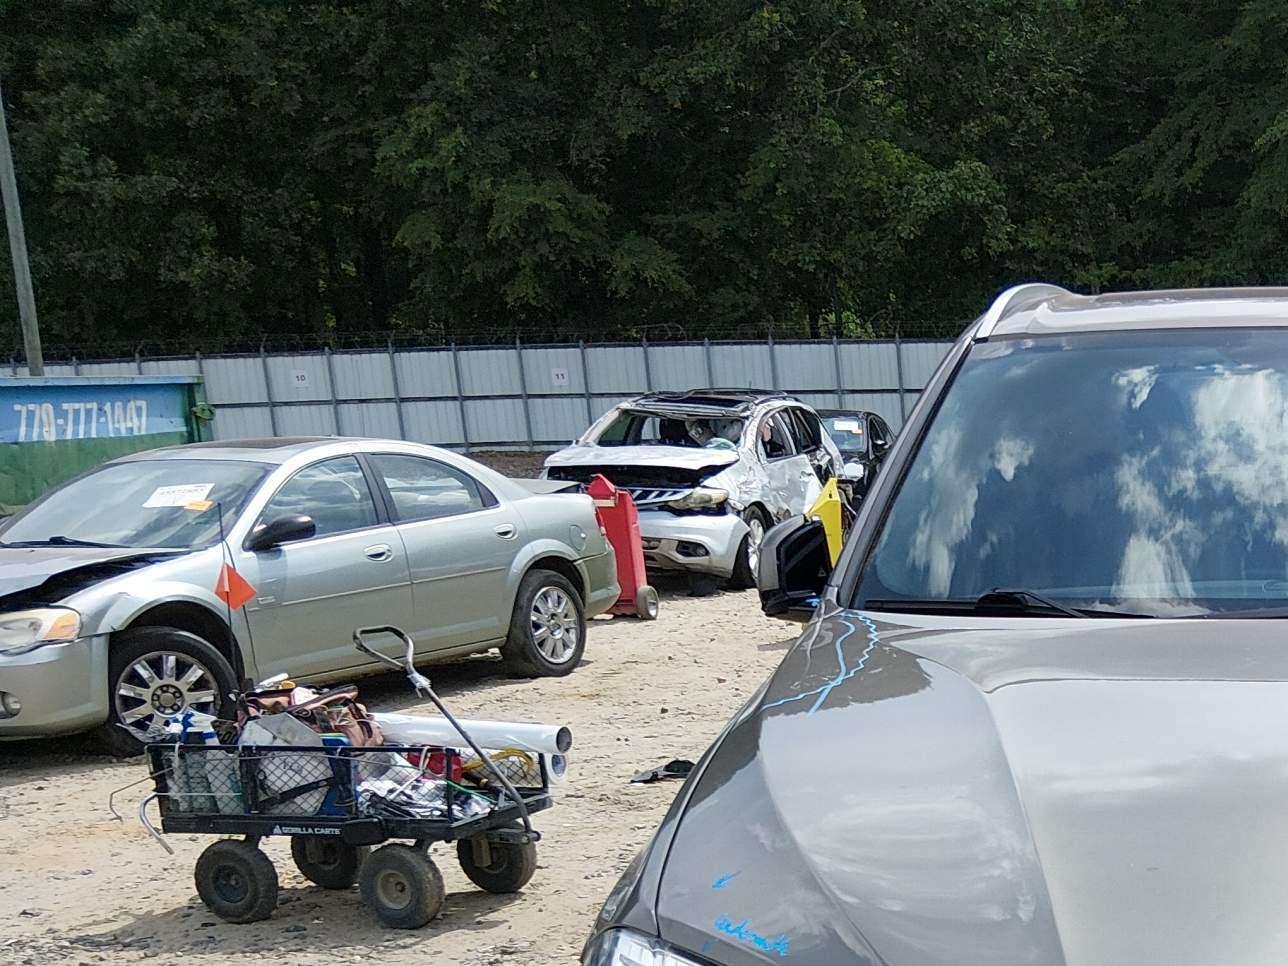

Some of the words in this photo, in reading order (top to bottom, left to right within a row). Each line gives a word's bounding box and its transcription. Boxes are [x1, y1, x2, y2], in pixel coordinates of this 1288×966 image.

[295, 374, 306, 382] 10
[555, 372, 565, 380] 11
[13, 400, 148, 446] 770-777-1447
